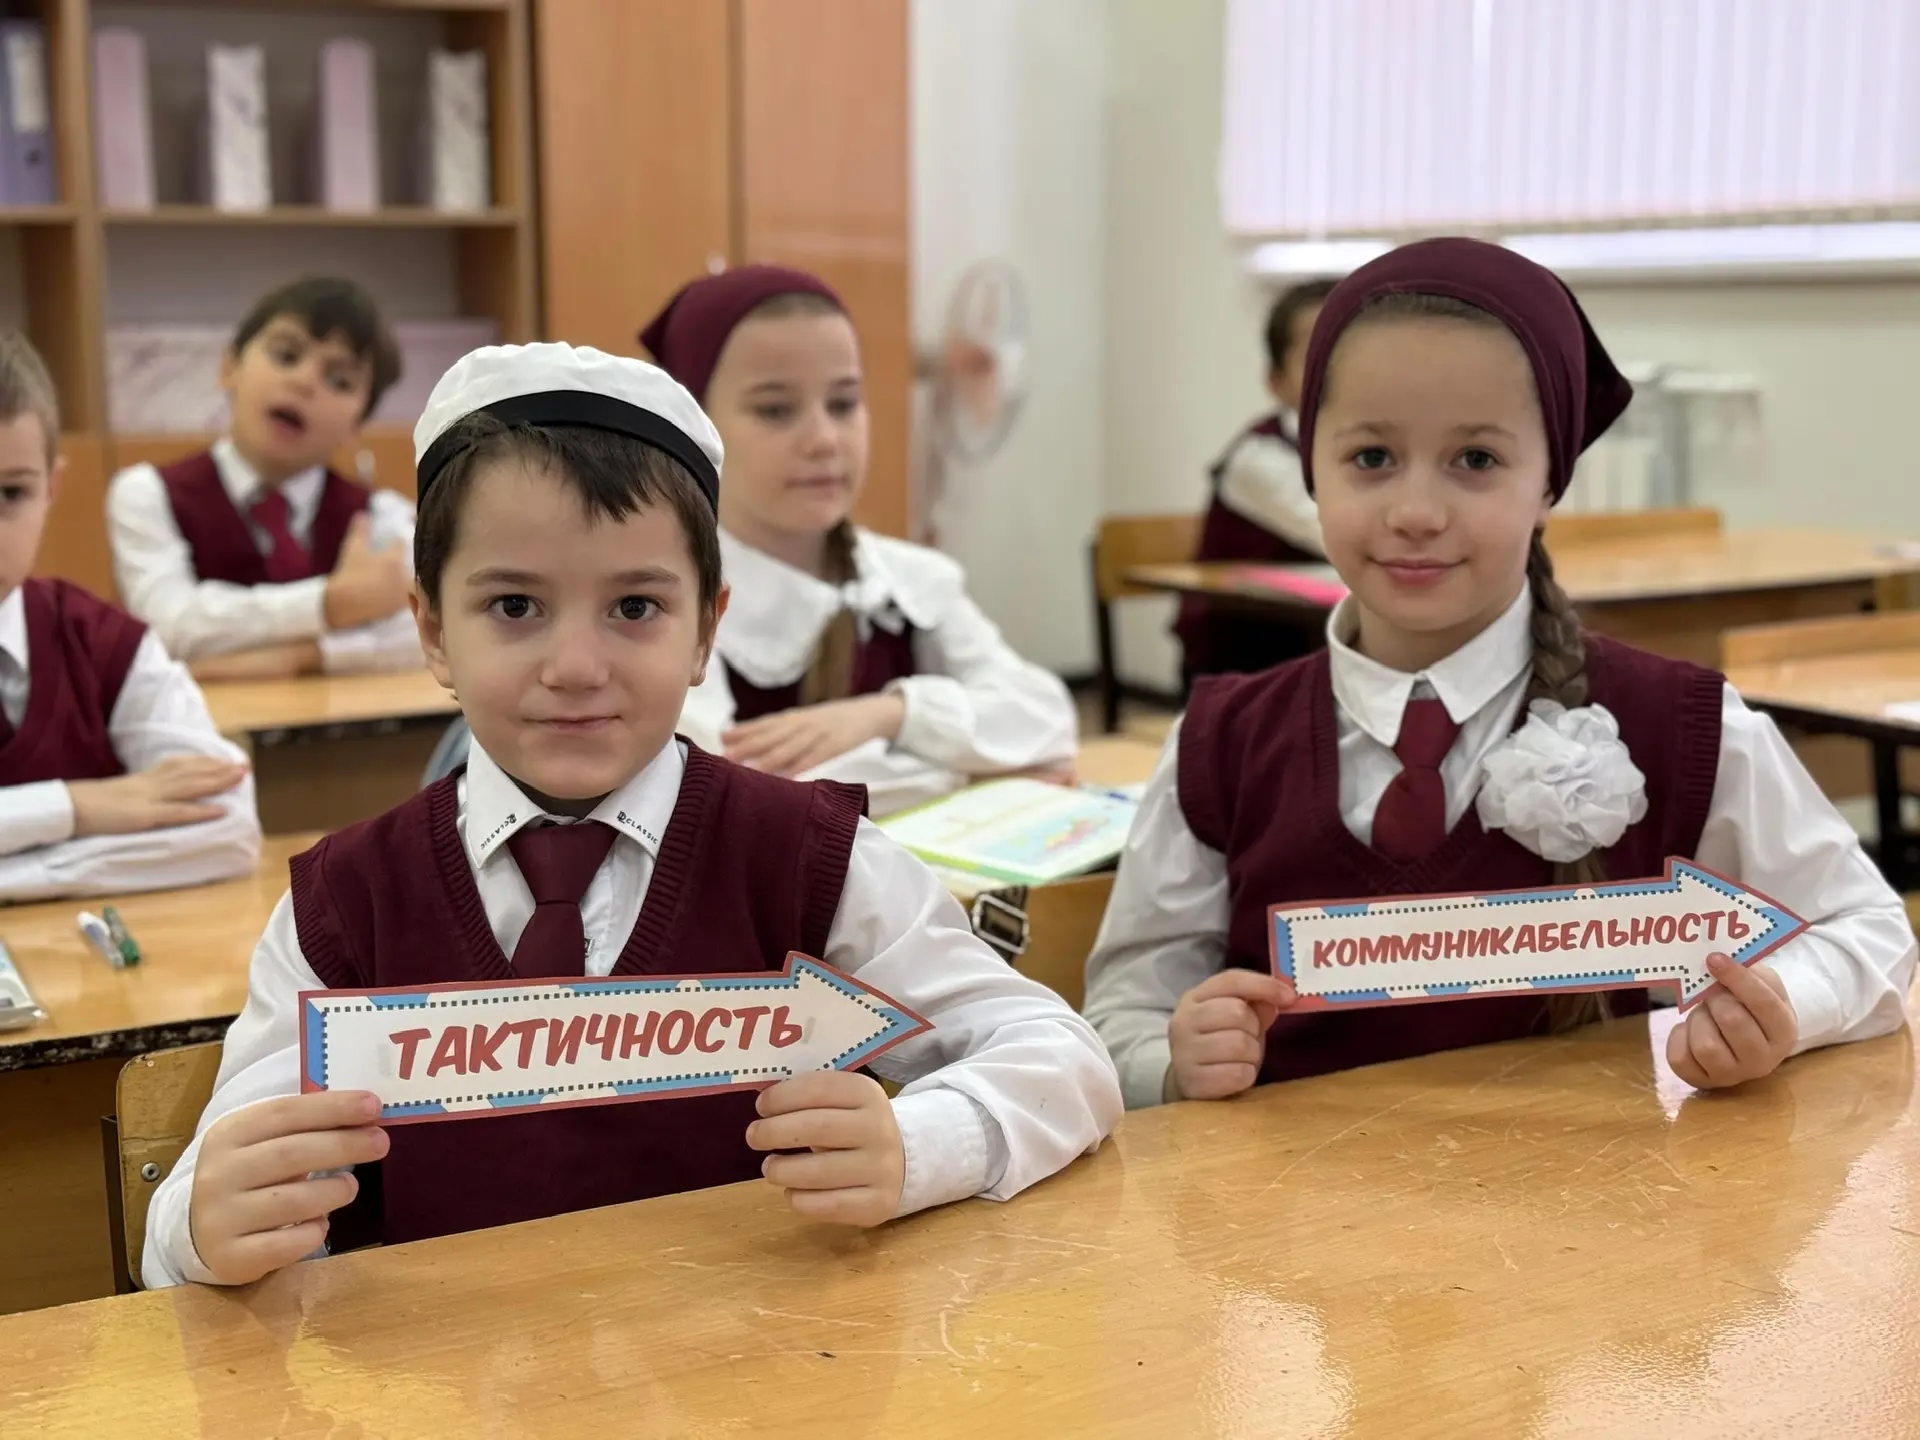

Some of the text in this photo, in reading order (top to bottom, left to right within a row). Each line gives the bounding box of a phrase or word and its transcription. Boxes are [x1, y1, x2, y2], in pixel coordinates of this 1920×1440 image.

[626, 818, 658, 845] CLASSIC
[1313, 910, 1750, 968] КОММУНИКАБЕЛЬНОСТЬ
[390, 1006, 803, 1080] ТАКТИЧНОСТЬ
